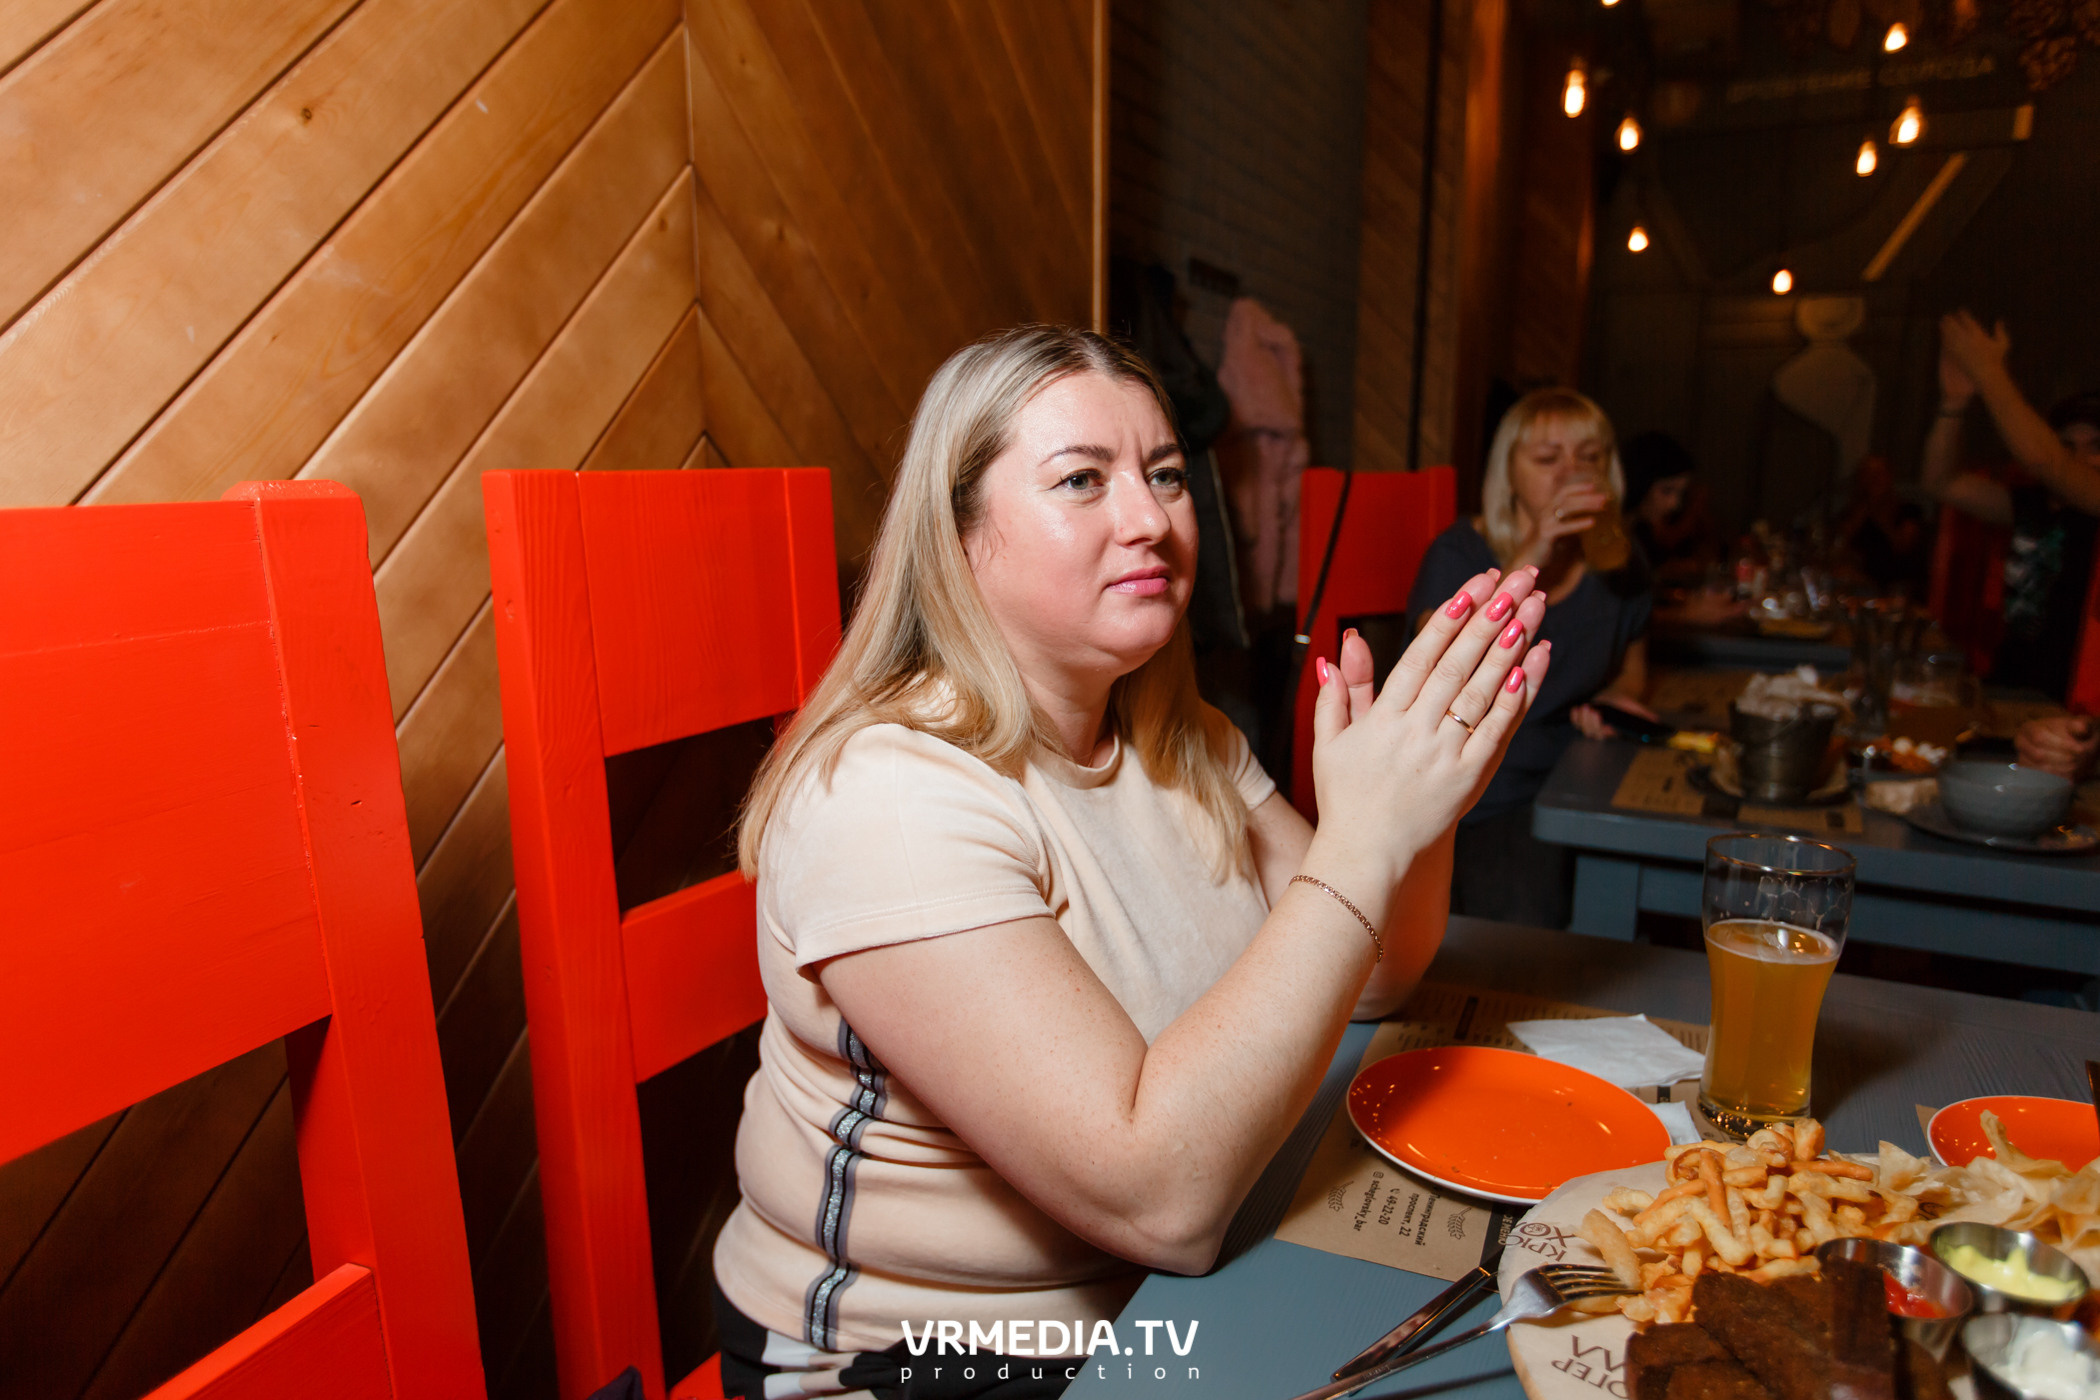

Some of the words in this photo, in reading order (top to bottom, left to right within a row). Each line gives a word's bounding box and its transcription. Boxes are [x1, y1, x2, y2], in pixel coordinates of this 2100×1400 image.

[1353, 1180, 1381, 1232] scheglovsky_bar
[1378, 1195, 1398, 1225] 49-22-20
[1400, 1193, 1419, 1225] проспект,
[1399, 1226, 1411, 1237] 22
